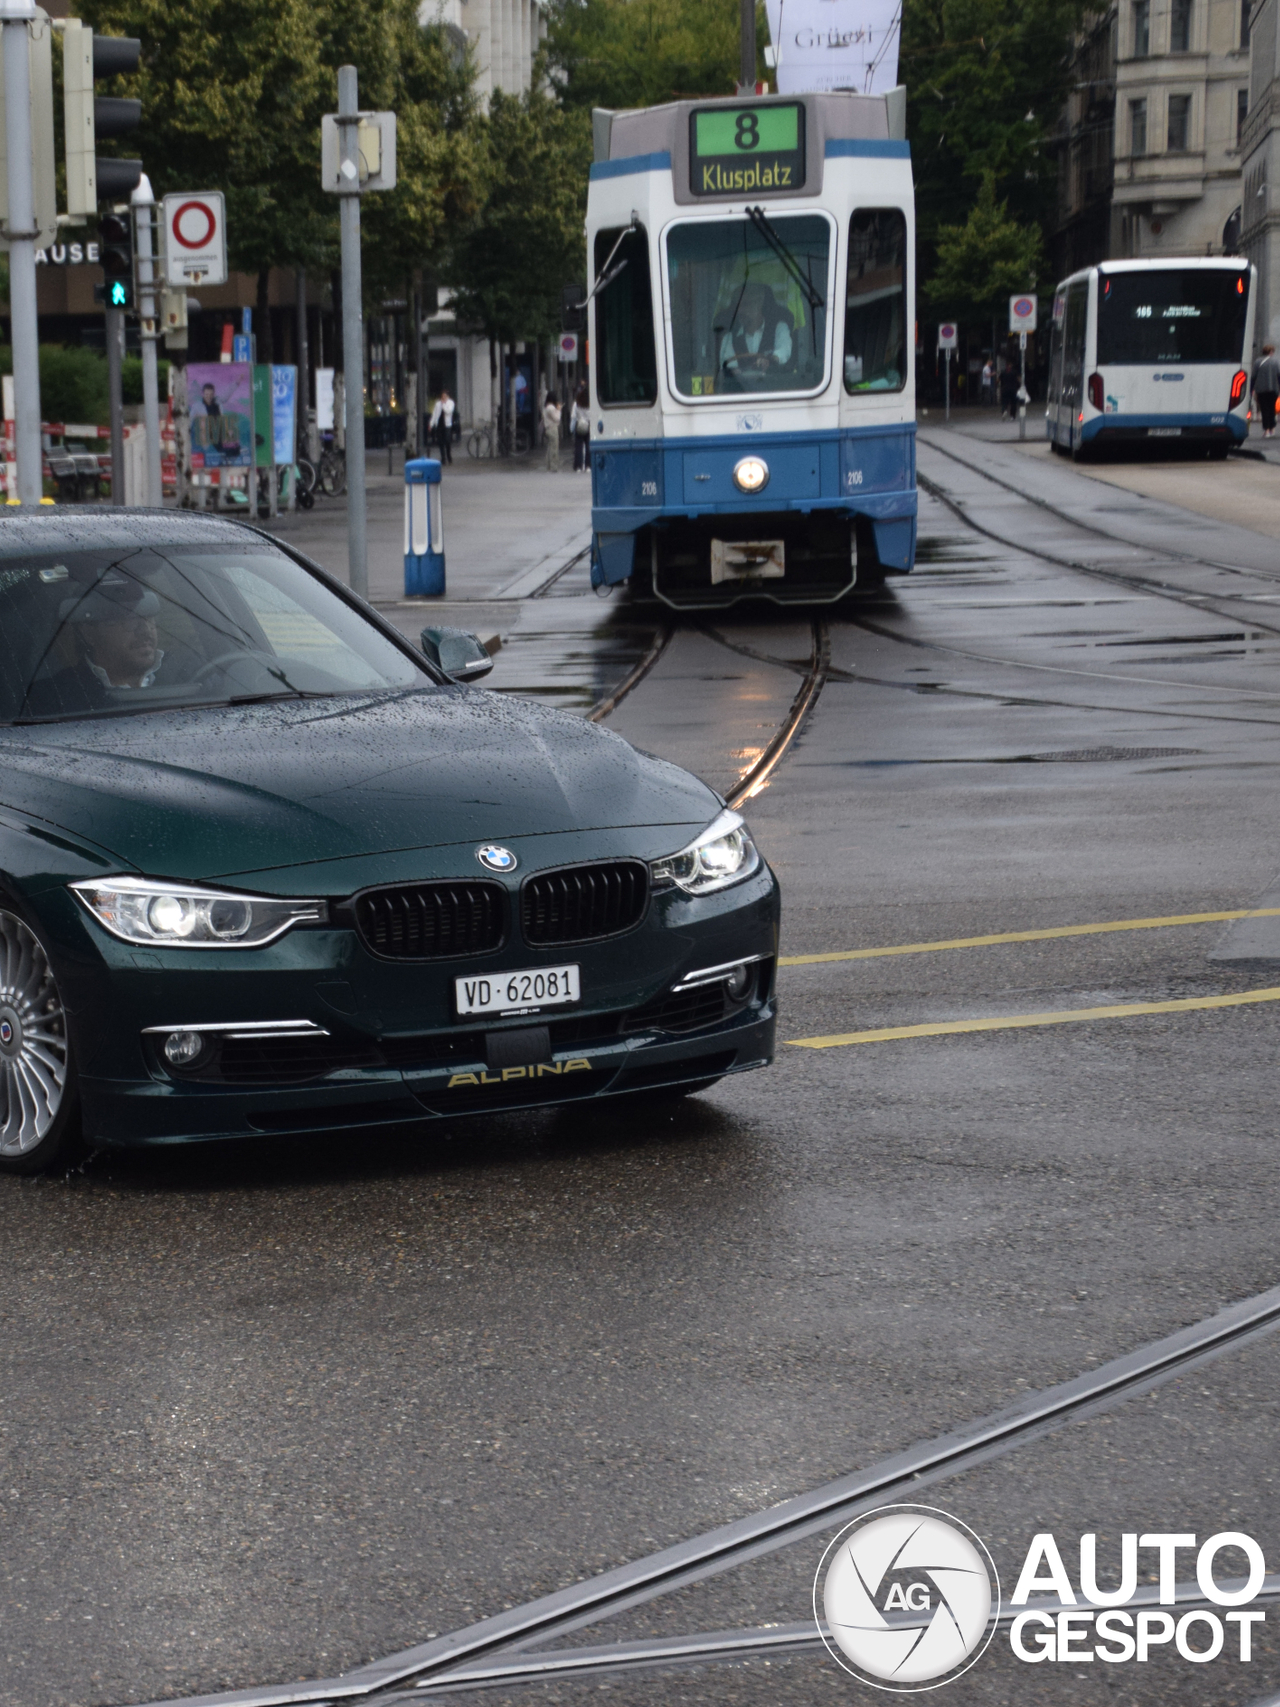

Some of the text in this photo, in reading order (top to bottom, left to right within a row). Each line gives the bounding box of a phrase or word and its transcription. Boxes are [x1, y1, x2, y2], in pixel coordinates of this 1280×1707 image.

[734, 112, 760, 150] 8
[703, 160, 792, 191] Klusplatz
[34, 242, 100, 264] AUSE
[642, 482, 657, 496] 2106
[848, 471, 863, 485] 2106
[447, 1058, 593, 1088] ALPINA
